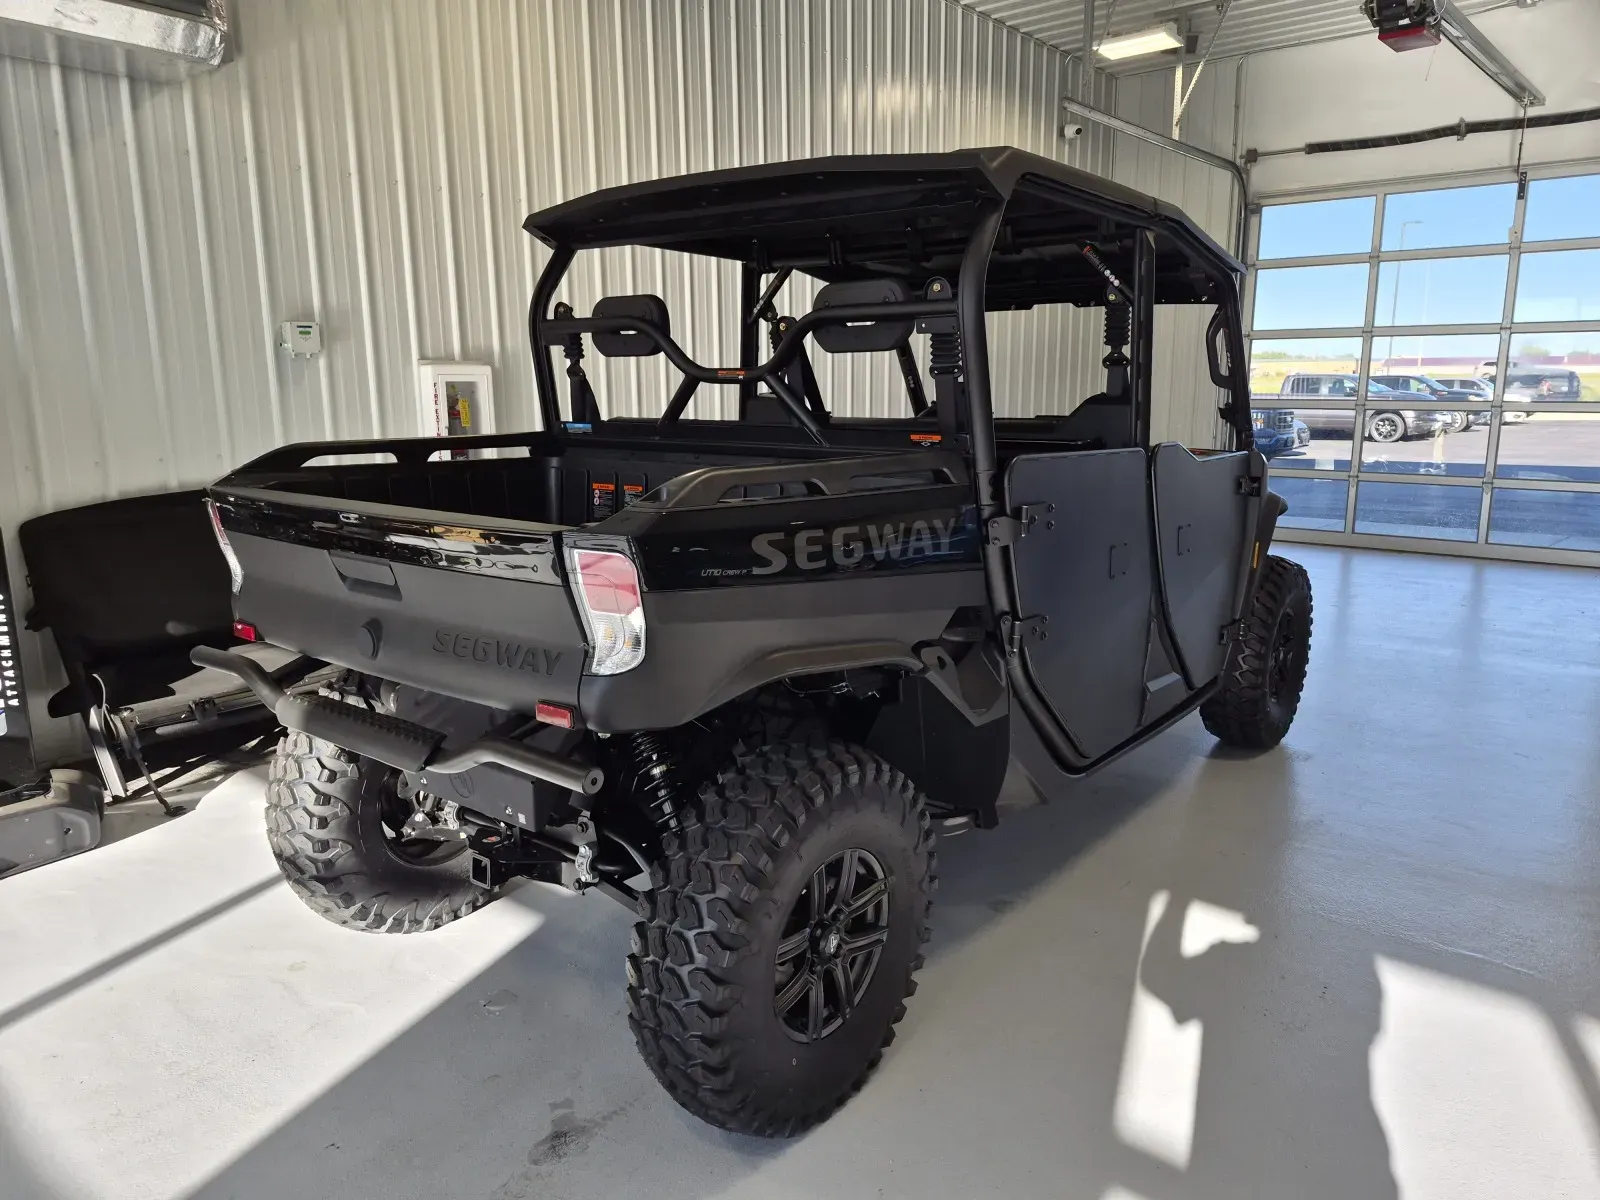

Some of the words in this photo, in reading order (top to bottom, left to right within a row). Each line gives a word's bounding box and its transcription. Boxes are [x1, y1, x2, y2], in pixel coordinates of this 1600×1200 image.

[722, 568, 741, 576] CREW
[751, 517, 956, 575] SEGWAY
[0, 594, 20, 706] ATTACHMEN
[432, 628, 563, 676] SEGWAY
